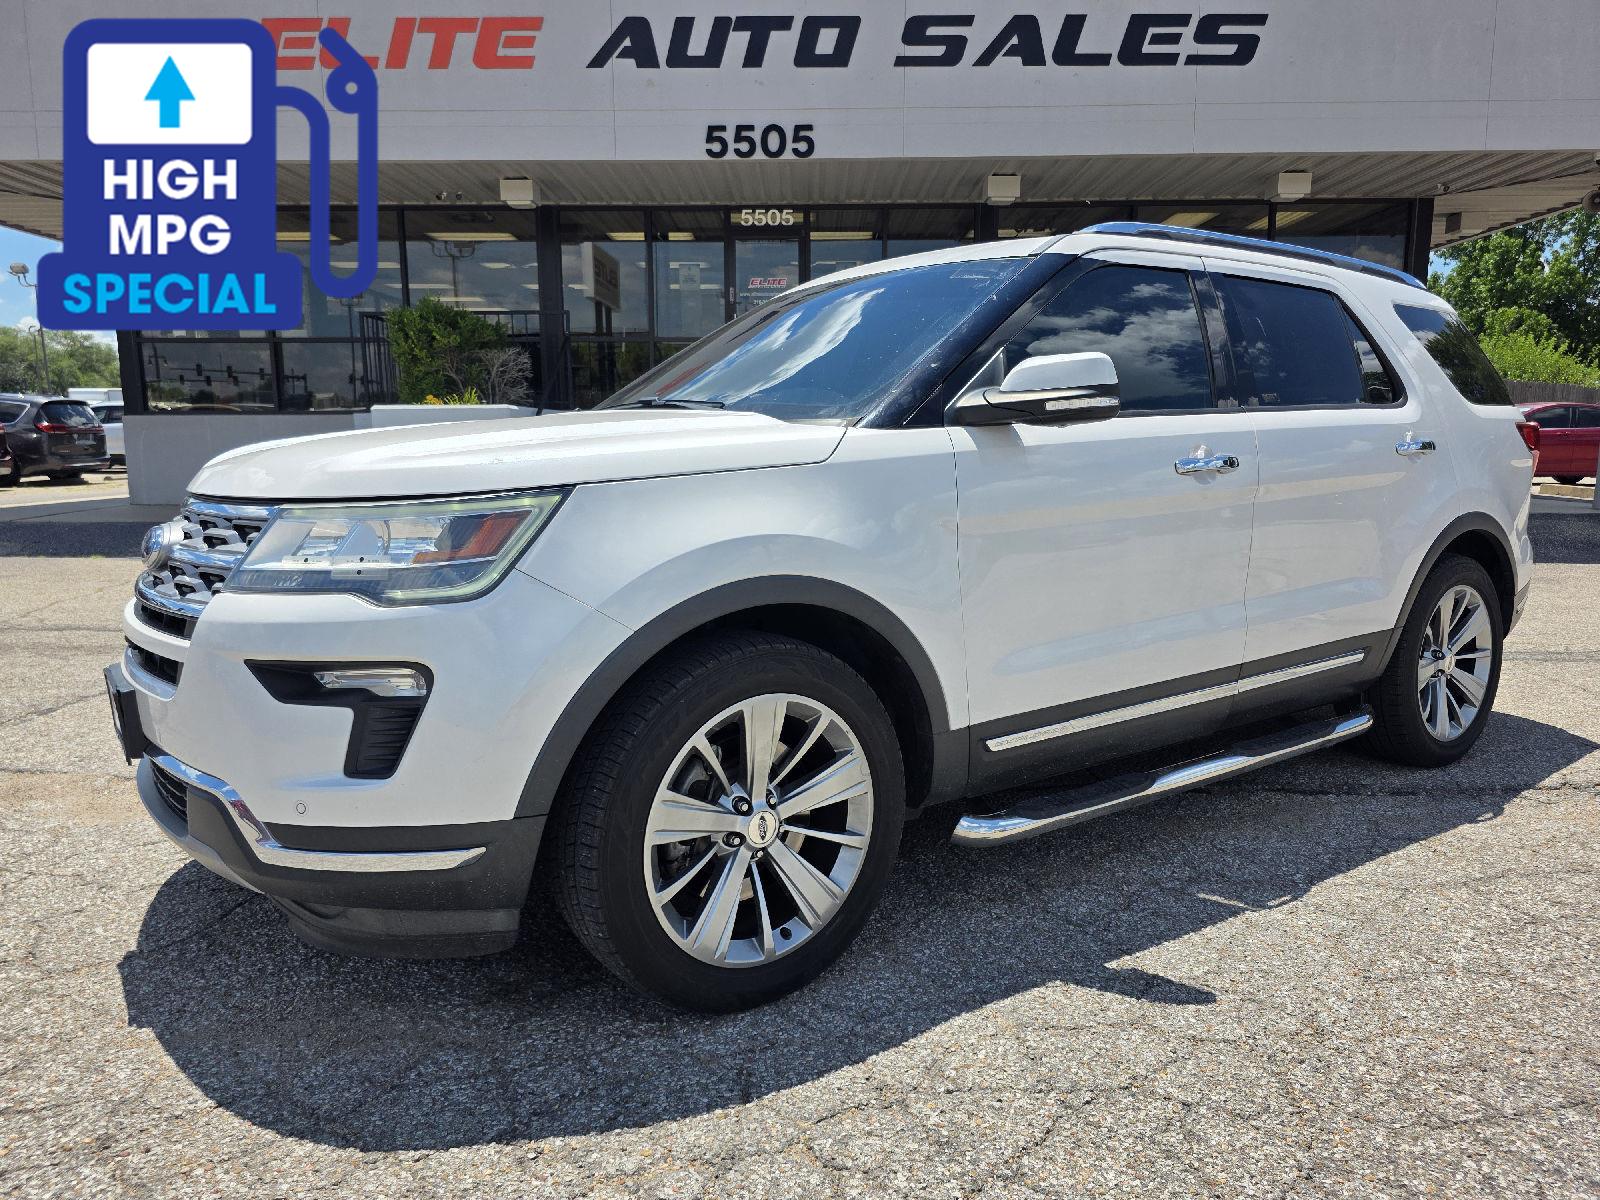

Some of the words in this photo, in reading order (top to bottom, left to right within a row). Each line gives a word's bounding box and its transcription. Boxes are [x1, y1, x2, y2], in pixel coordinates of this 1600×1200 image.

[586, 16, 861, 69] AUTO
[894, 14, 1269, 67] SALES
[705, 124, 815, 159] 5505
[740, 209, 794, 226] 5505
[750, 278, 787, 287] ELITE
